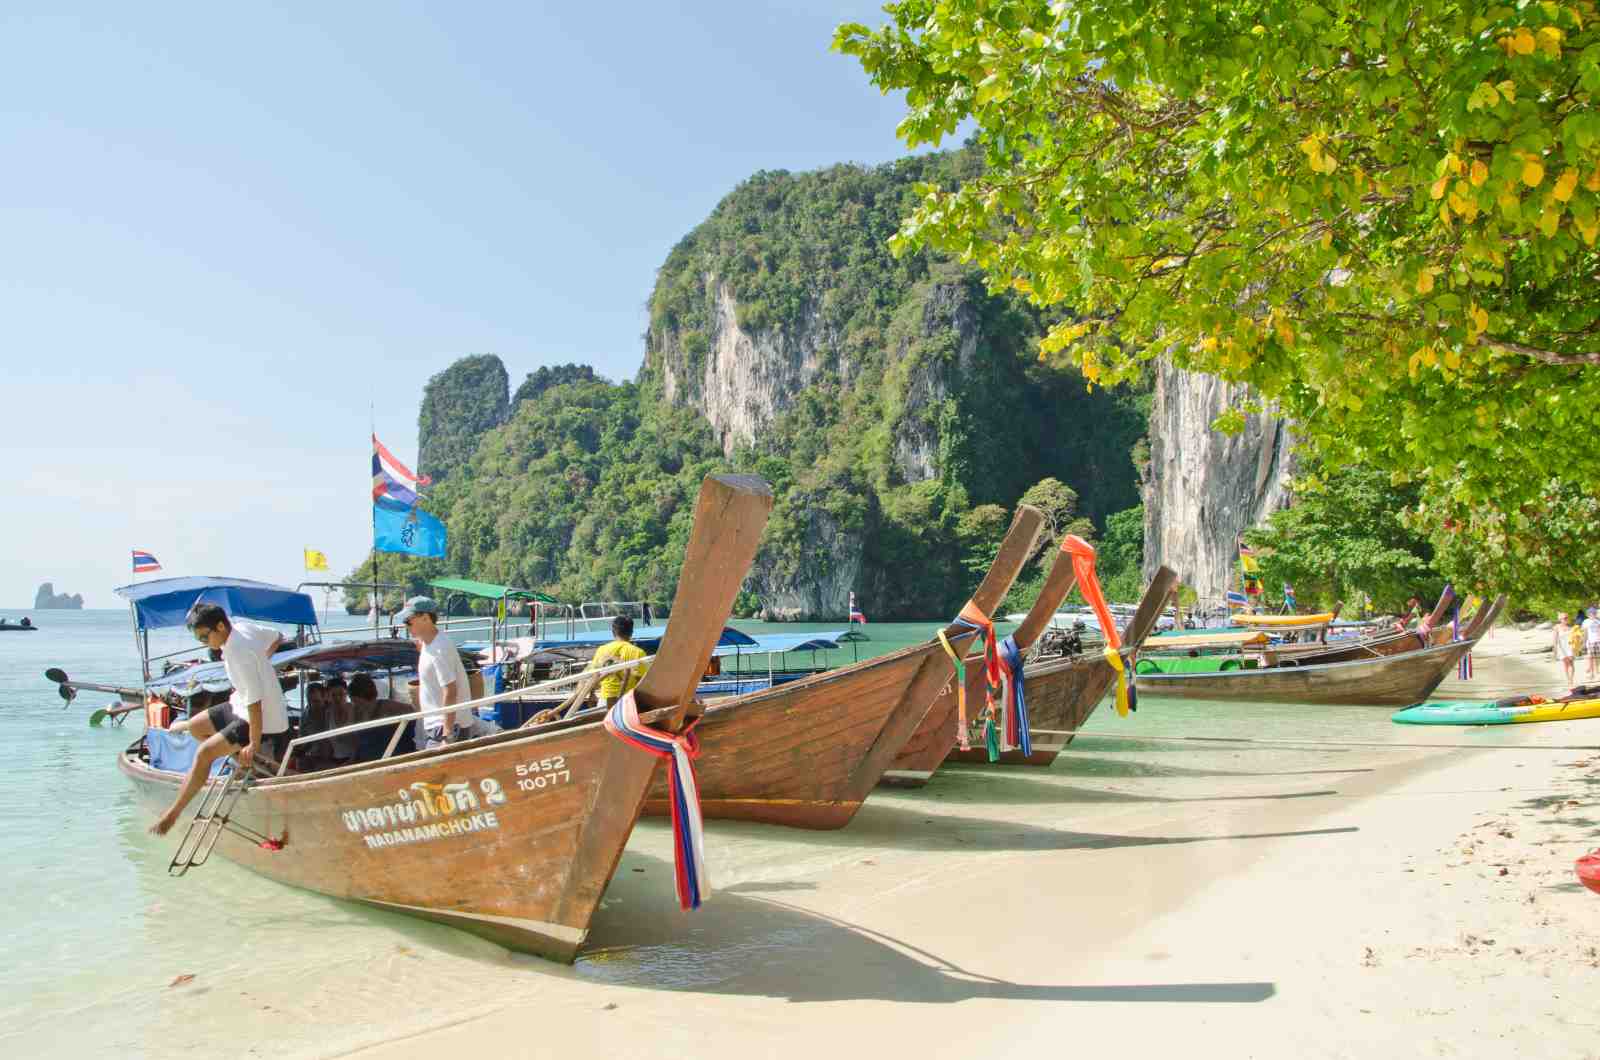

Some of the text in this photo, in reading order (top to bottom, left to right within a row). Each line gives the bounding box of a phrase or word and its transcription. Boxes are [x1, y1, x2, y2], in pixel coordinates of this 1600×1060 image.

[515, 755, 566, 776] 5452
[516, 769, 570, 792] 10077
[364, 812, 499, 848] NADANAMCHOKE
